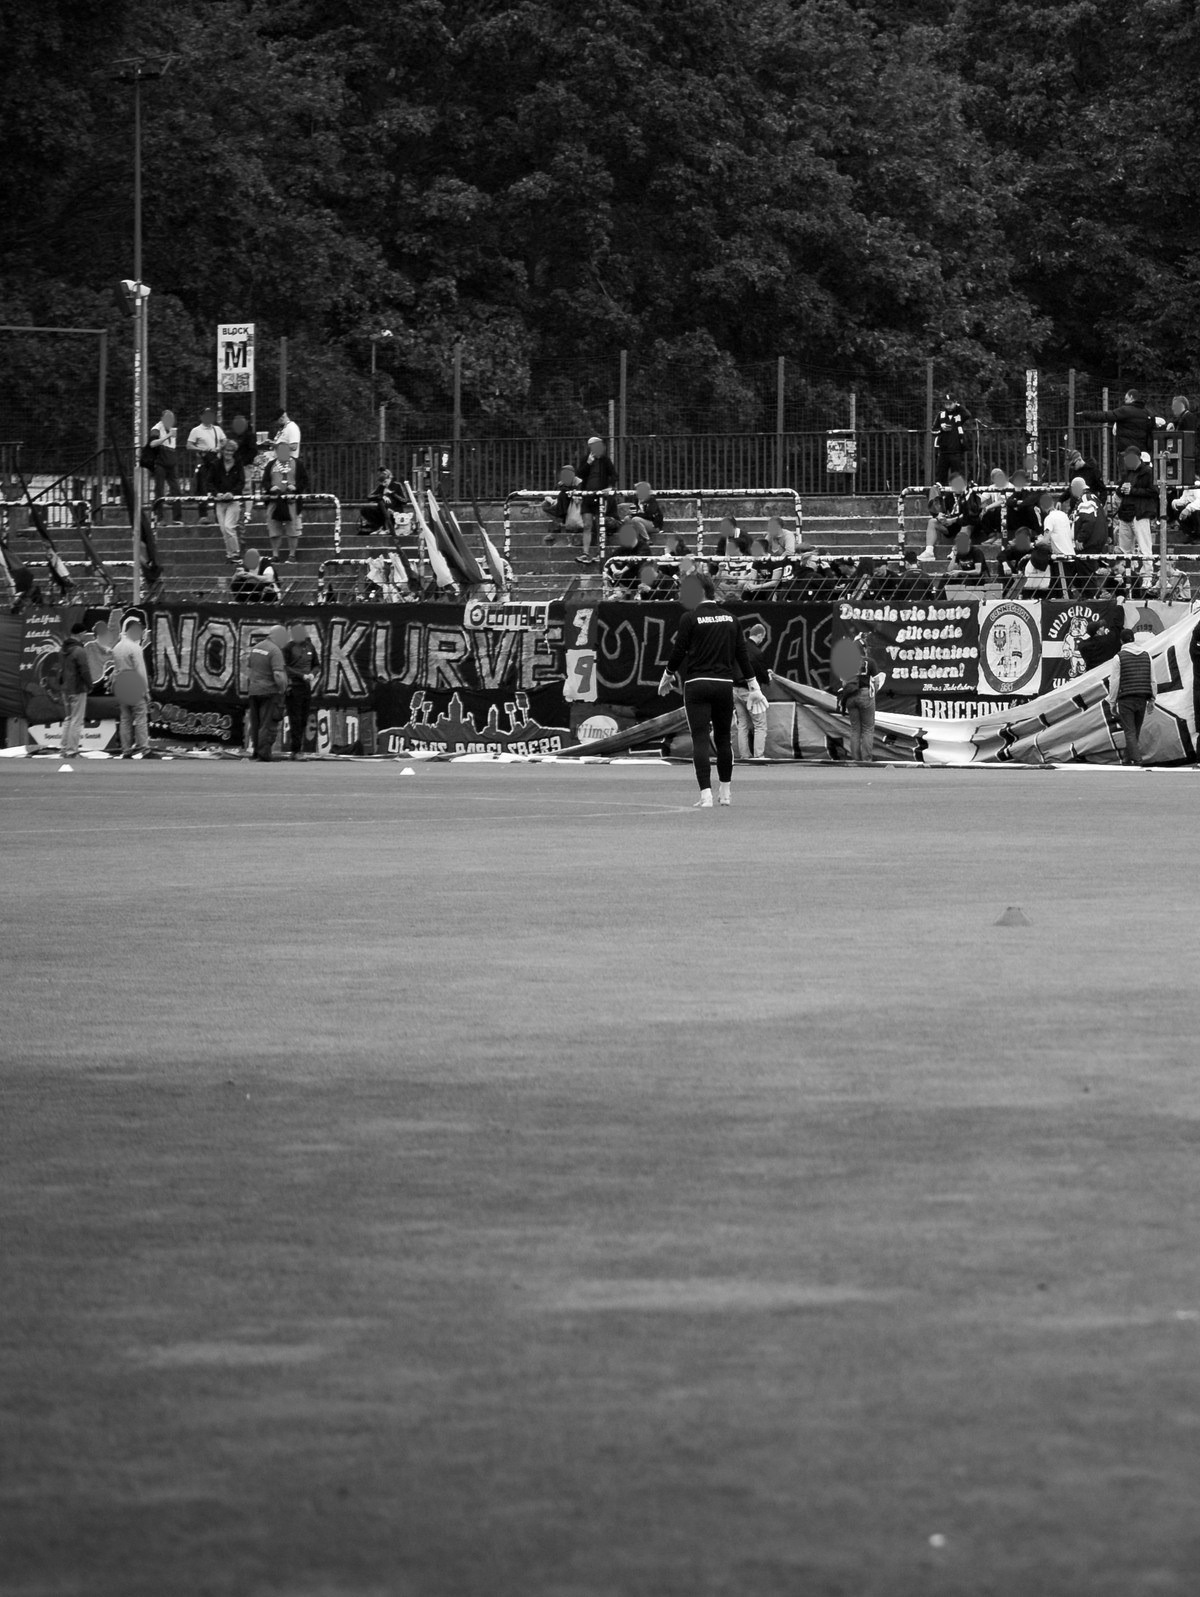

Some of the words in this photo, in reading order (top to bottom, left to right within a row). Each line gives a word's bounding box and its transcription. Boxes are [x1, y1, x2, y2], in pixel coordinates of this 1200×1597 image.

[222, 327, 249, 335] BLOCK
[222, 341, 247, 370] M
[697, 614, 734, 624] BABELSBERG
[839, 603, 898, 622] Damals
[900, 606, 926, 621] wie
[927, 604, 971, 621] heute
[990, 603, 1031, 622] CONNECTION
[1048, 605, 1100, 639] UNDERDO
[940, 624, 963, 640] die
[886, 645, 978, 661] Verhältnisse
[892, 667, 909, 679] zu
[910, 663, 965, 679] ändern!
